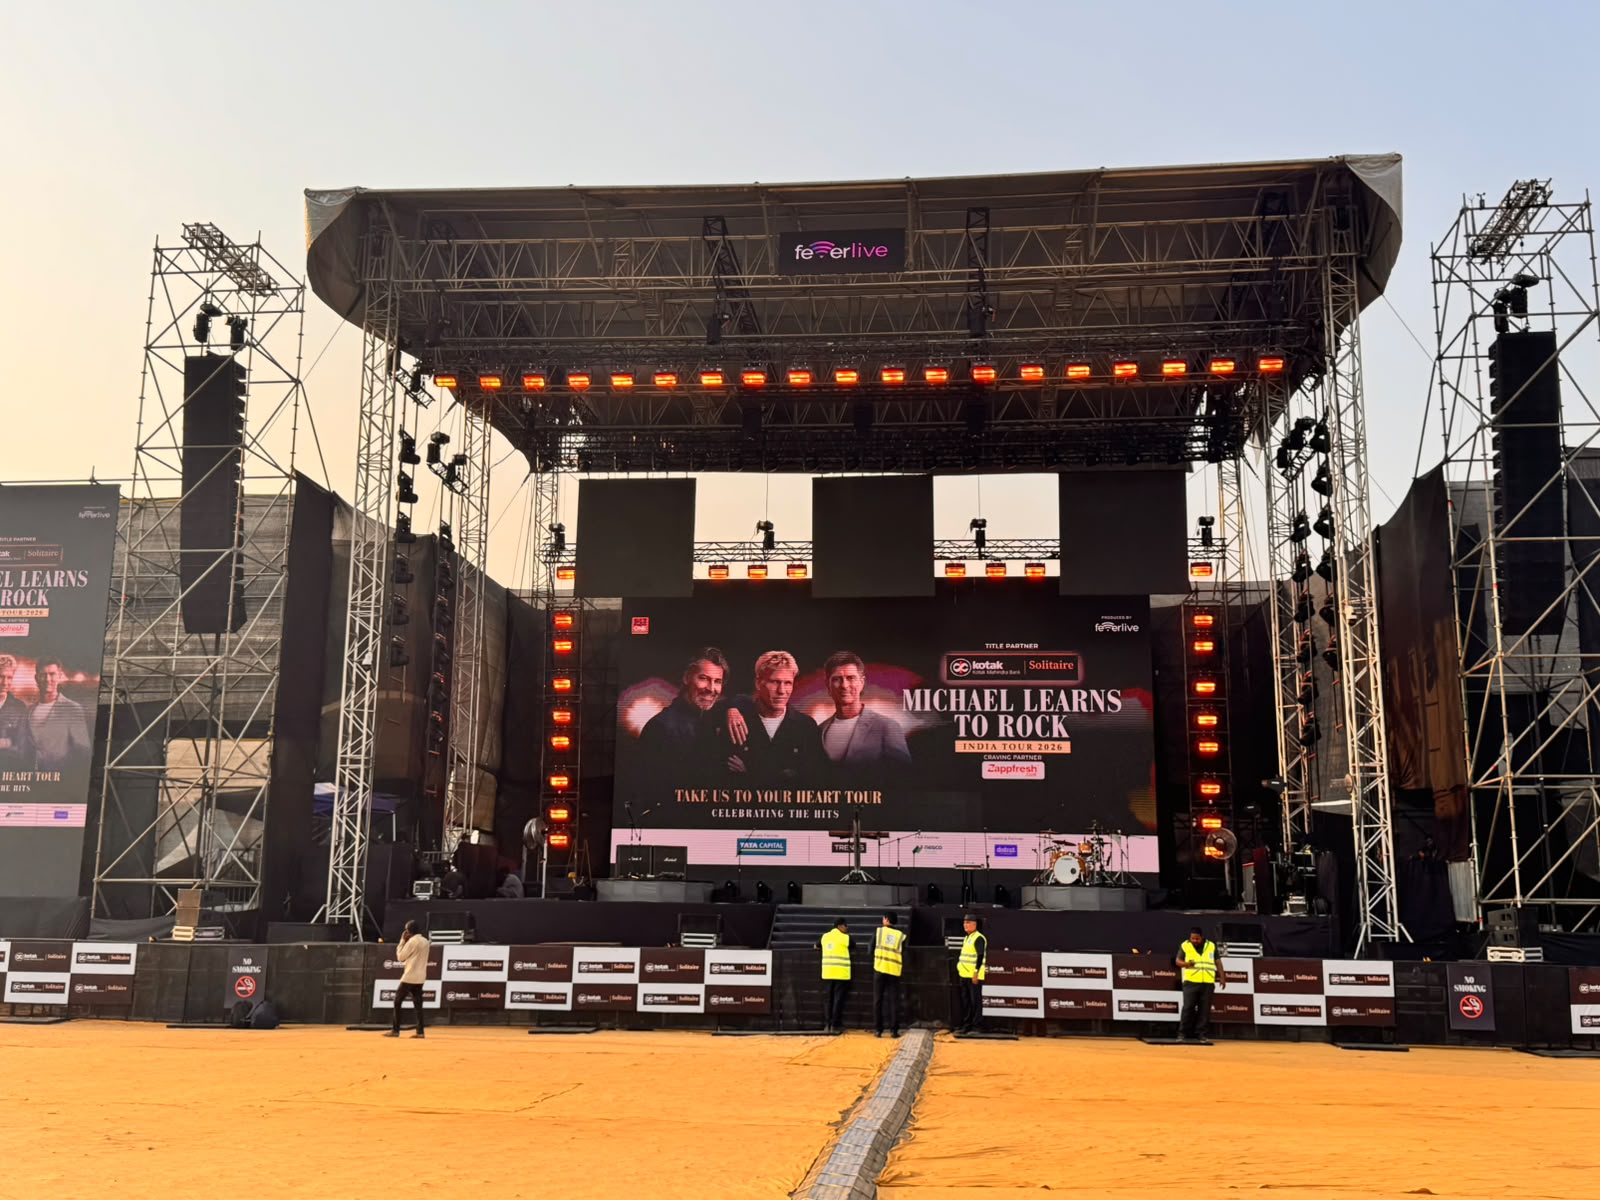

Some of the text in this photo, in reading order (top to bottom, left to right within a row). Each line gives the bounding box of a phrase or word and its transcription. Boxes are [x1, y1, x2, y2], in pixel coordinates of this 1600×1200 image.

[20, 570, 88, 588] LEARNS
[0, 588, 48, 606] ROCK
[972, 661, 1074, 670] kotak Solitaire
[902, 689, 1122, 713] MICHAEL LEARNS
[954, 714, 1069, 738] TO ROCK
[987, 764, 1038, 774] Zappfresh
[2, 772, 60, 781] HEART TOUR
[675, 789, 882, 804] TAKE US TO YOUR HEART TOUR
[712, 808, 839, 819] CELEBRATING THE HITS
[1454, 984, 1486, 992] SMOKING
